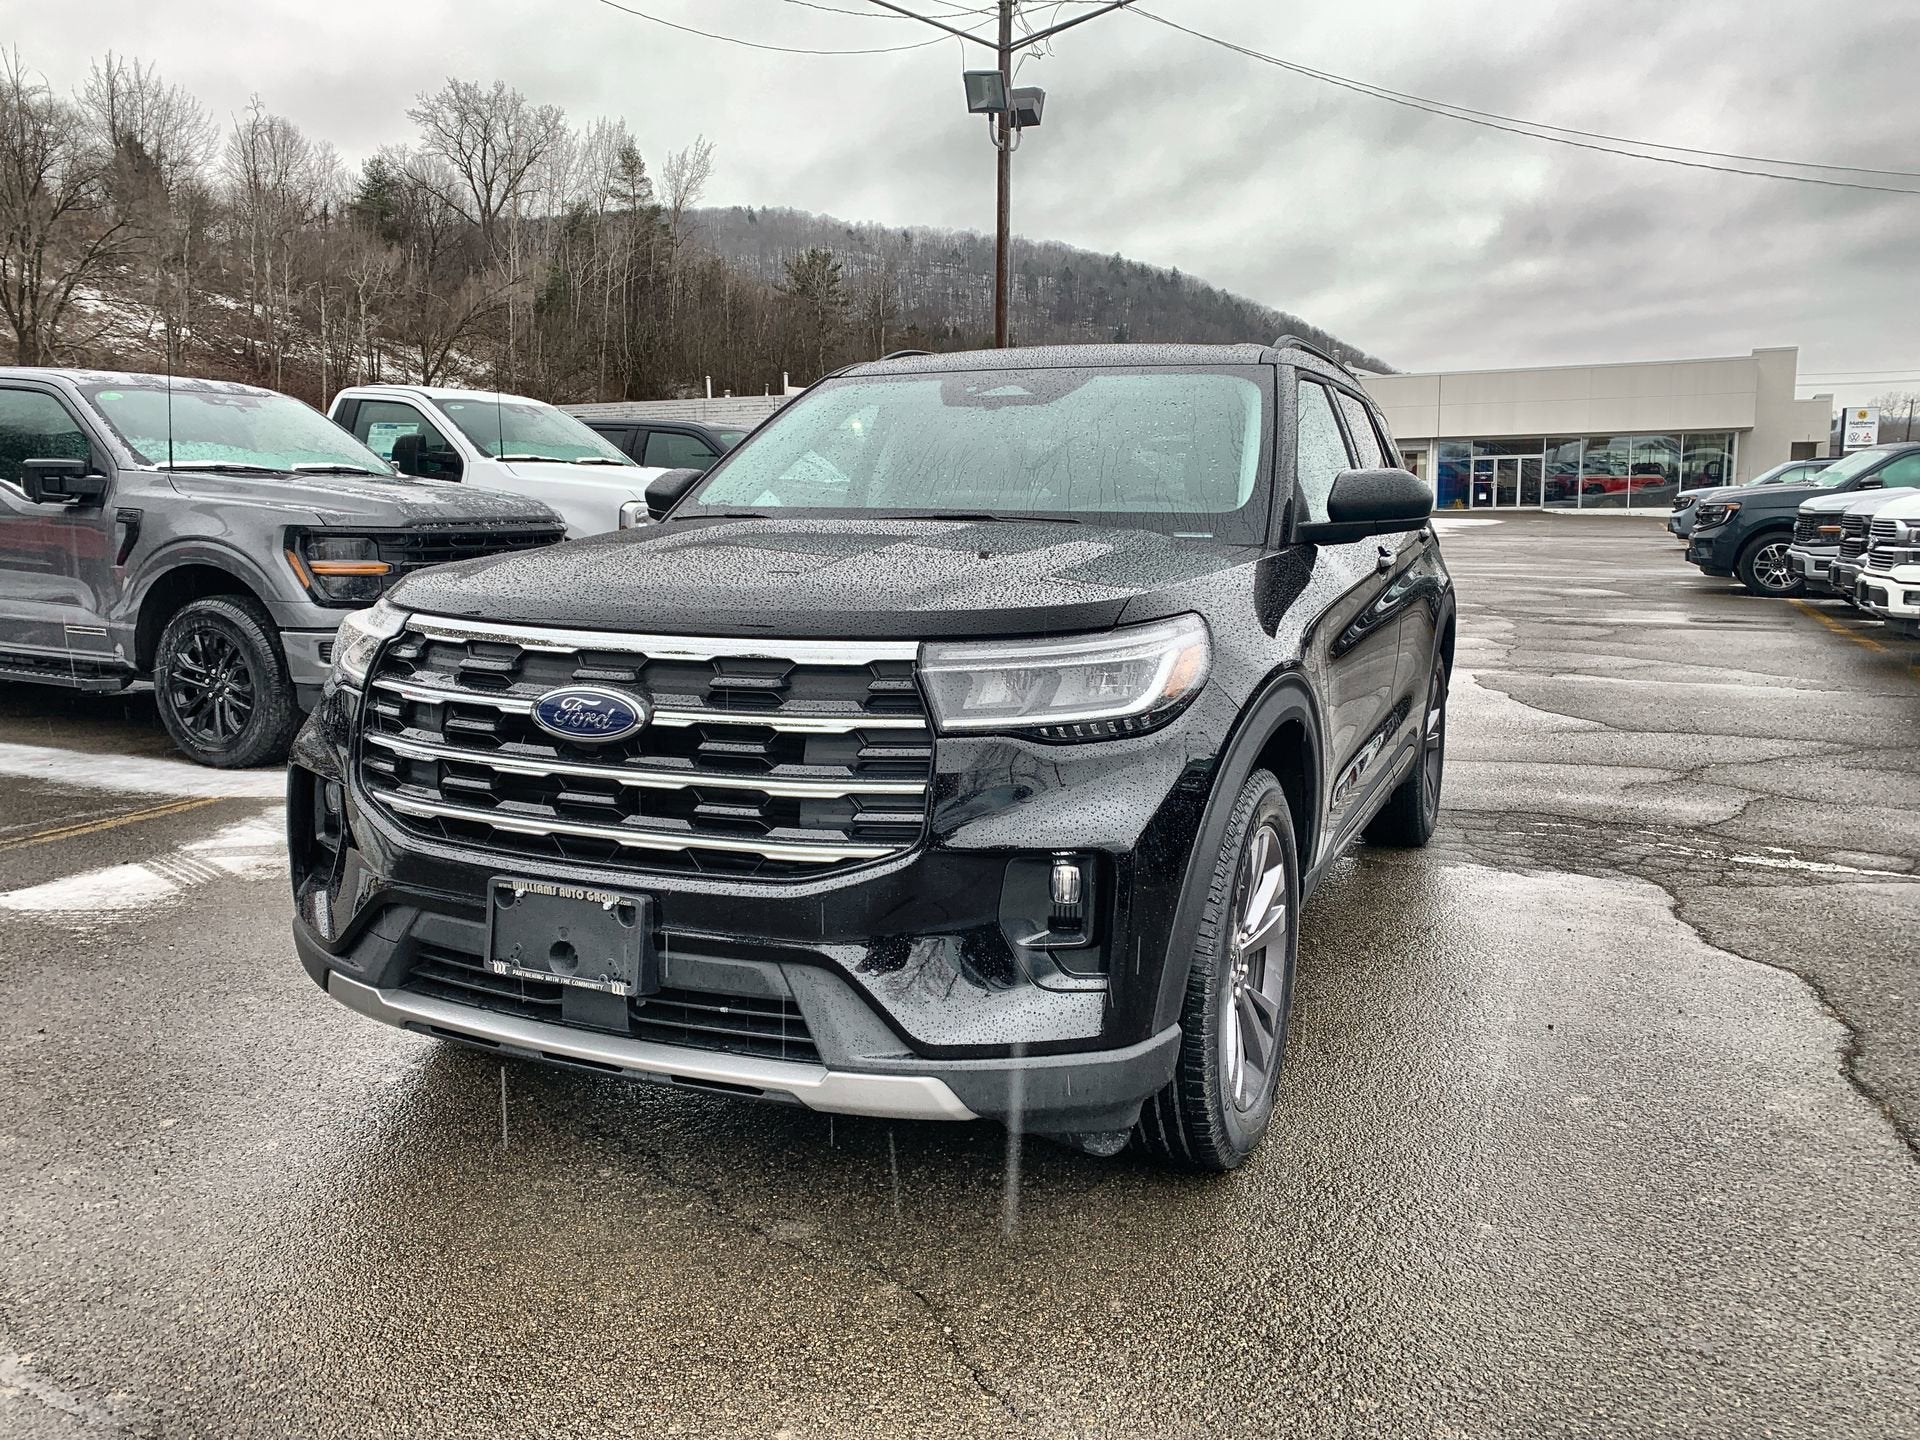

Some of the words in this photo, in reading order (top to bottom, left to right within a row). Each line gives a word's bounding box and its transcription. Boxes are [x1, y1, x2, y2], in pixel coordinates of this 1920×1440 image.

[553, 697, 616, 729] Ford
[559, 887, 584, 900] AUTO
[512, 969, 544, 980] PARTNERING
[545, 974, 560, 984] WITH
[560, 976, 571, 985] THE
[571, 979, 605, 991] COMMUNITY
